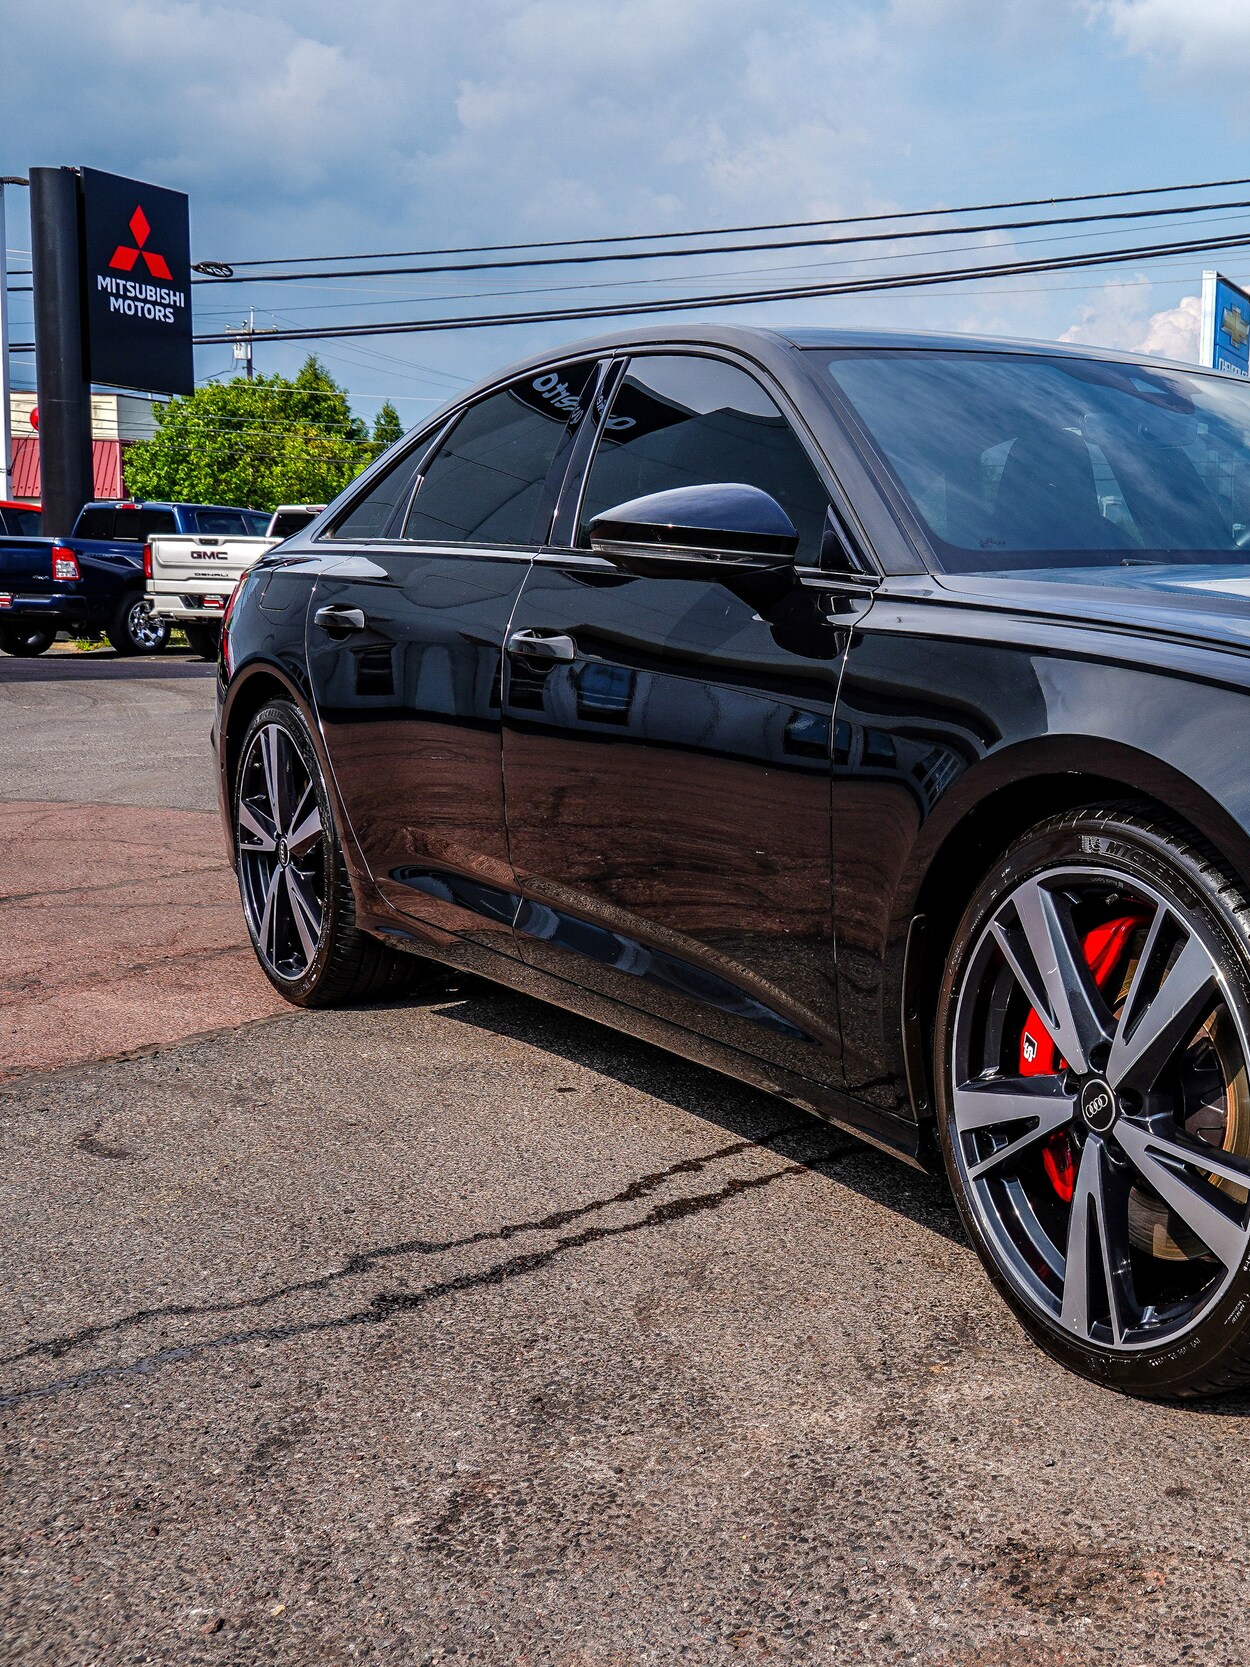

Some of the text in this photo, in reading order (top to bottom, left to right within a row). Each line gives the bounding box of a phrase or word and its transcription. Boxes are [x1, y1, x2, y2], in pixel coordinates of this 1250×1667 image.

[97, 275, 185, 308] MITSUBISHI
[109, 296, 175, 323] MOTORS
[190, 551, 229, 560] GMC
